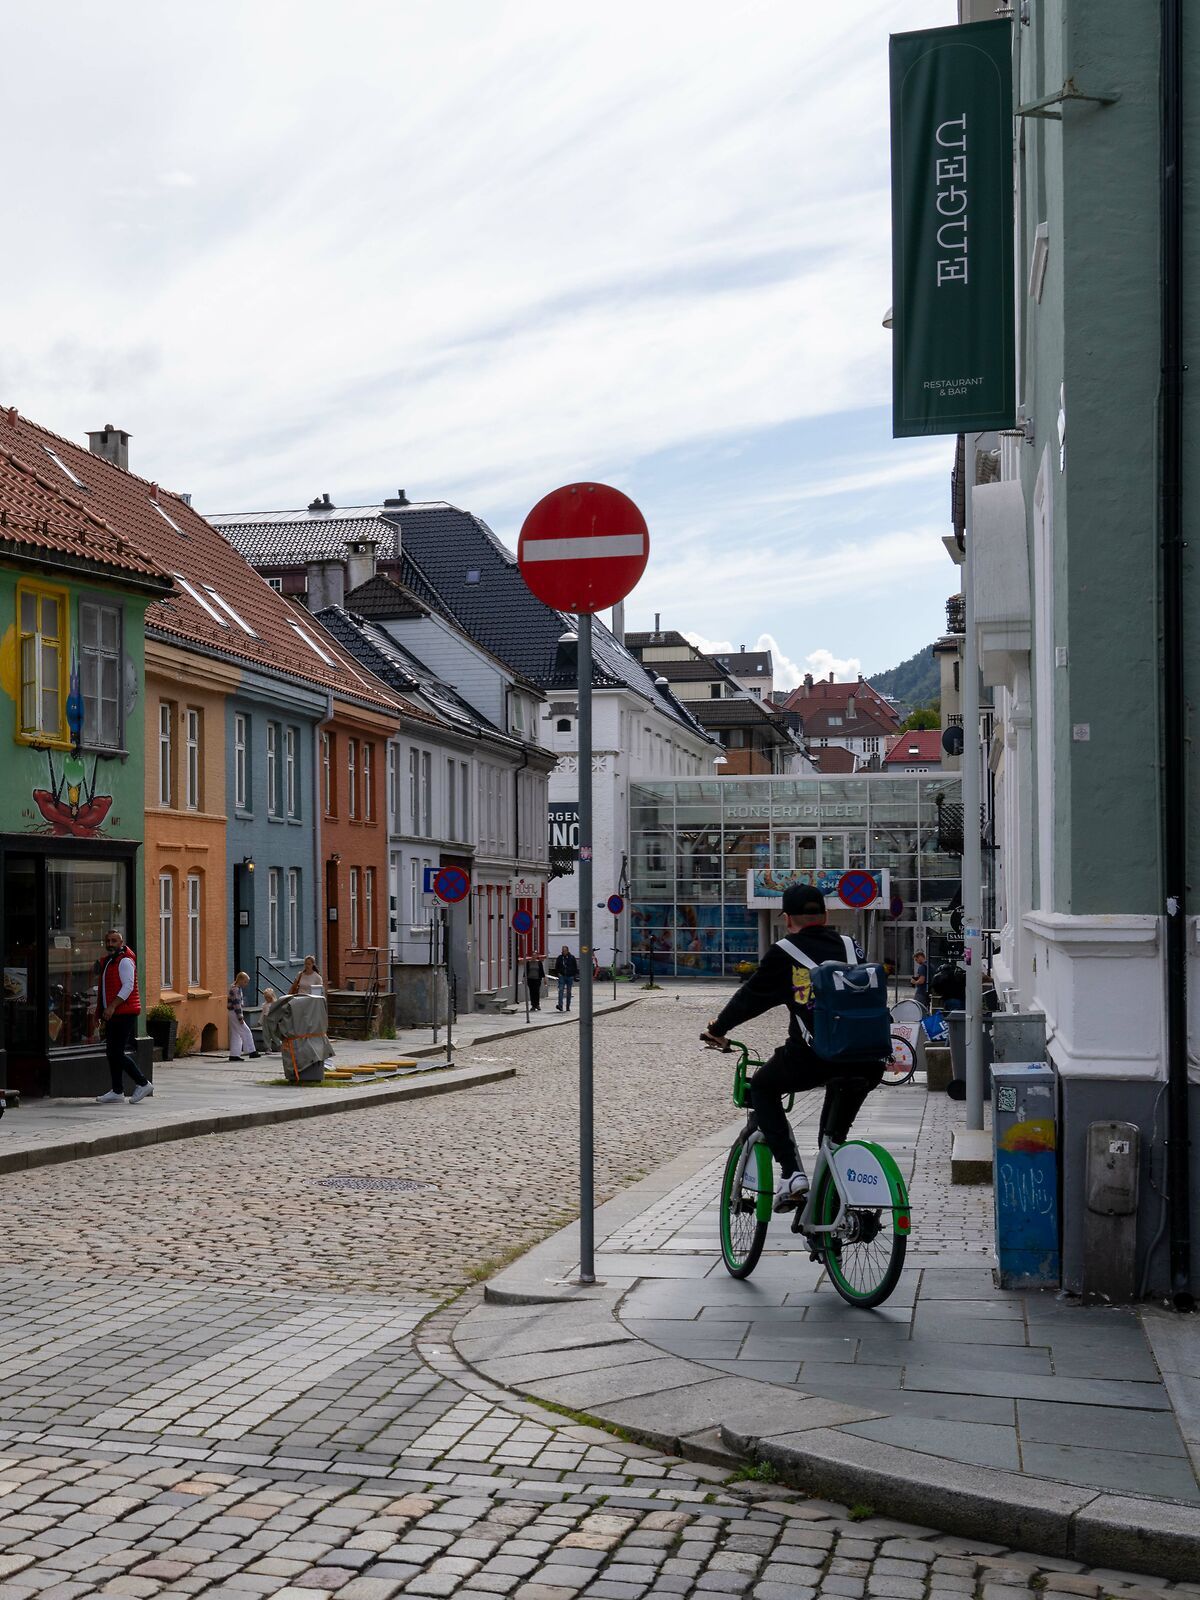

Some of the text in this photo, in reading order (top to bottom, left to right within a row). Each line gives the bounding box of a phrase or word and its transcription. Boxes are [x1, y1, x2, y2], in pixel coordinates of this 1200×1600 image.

[936, 112, 968, 287] ENGEN
[923, 377, 984, 389] RESTAURANT
[948, 387, 968, 396] BAR
[857, 1173, 878, 1185] OBOS
